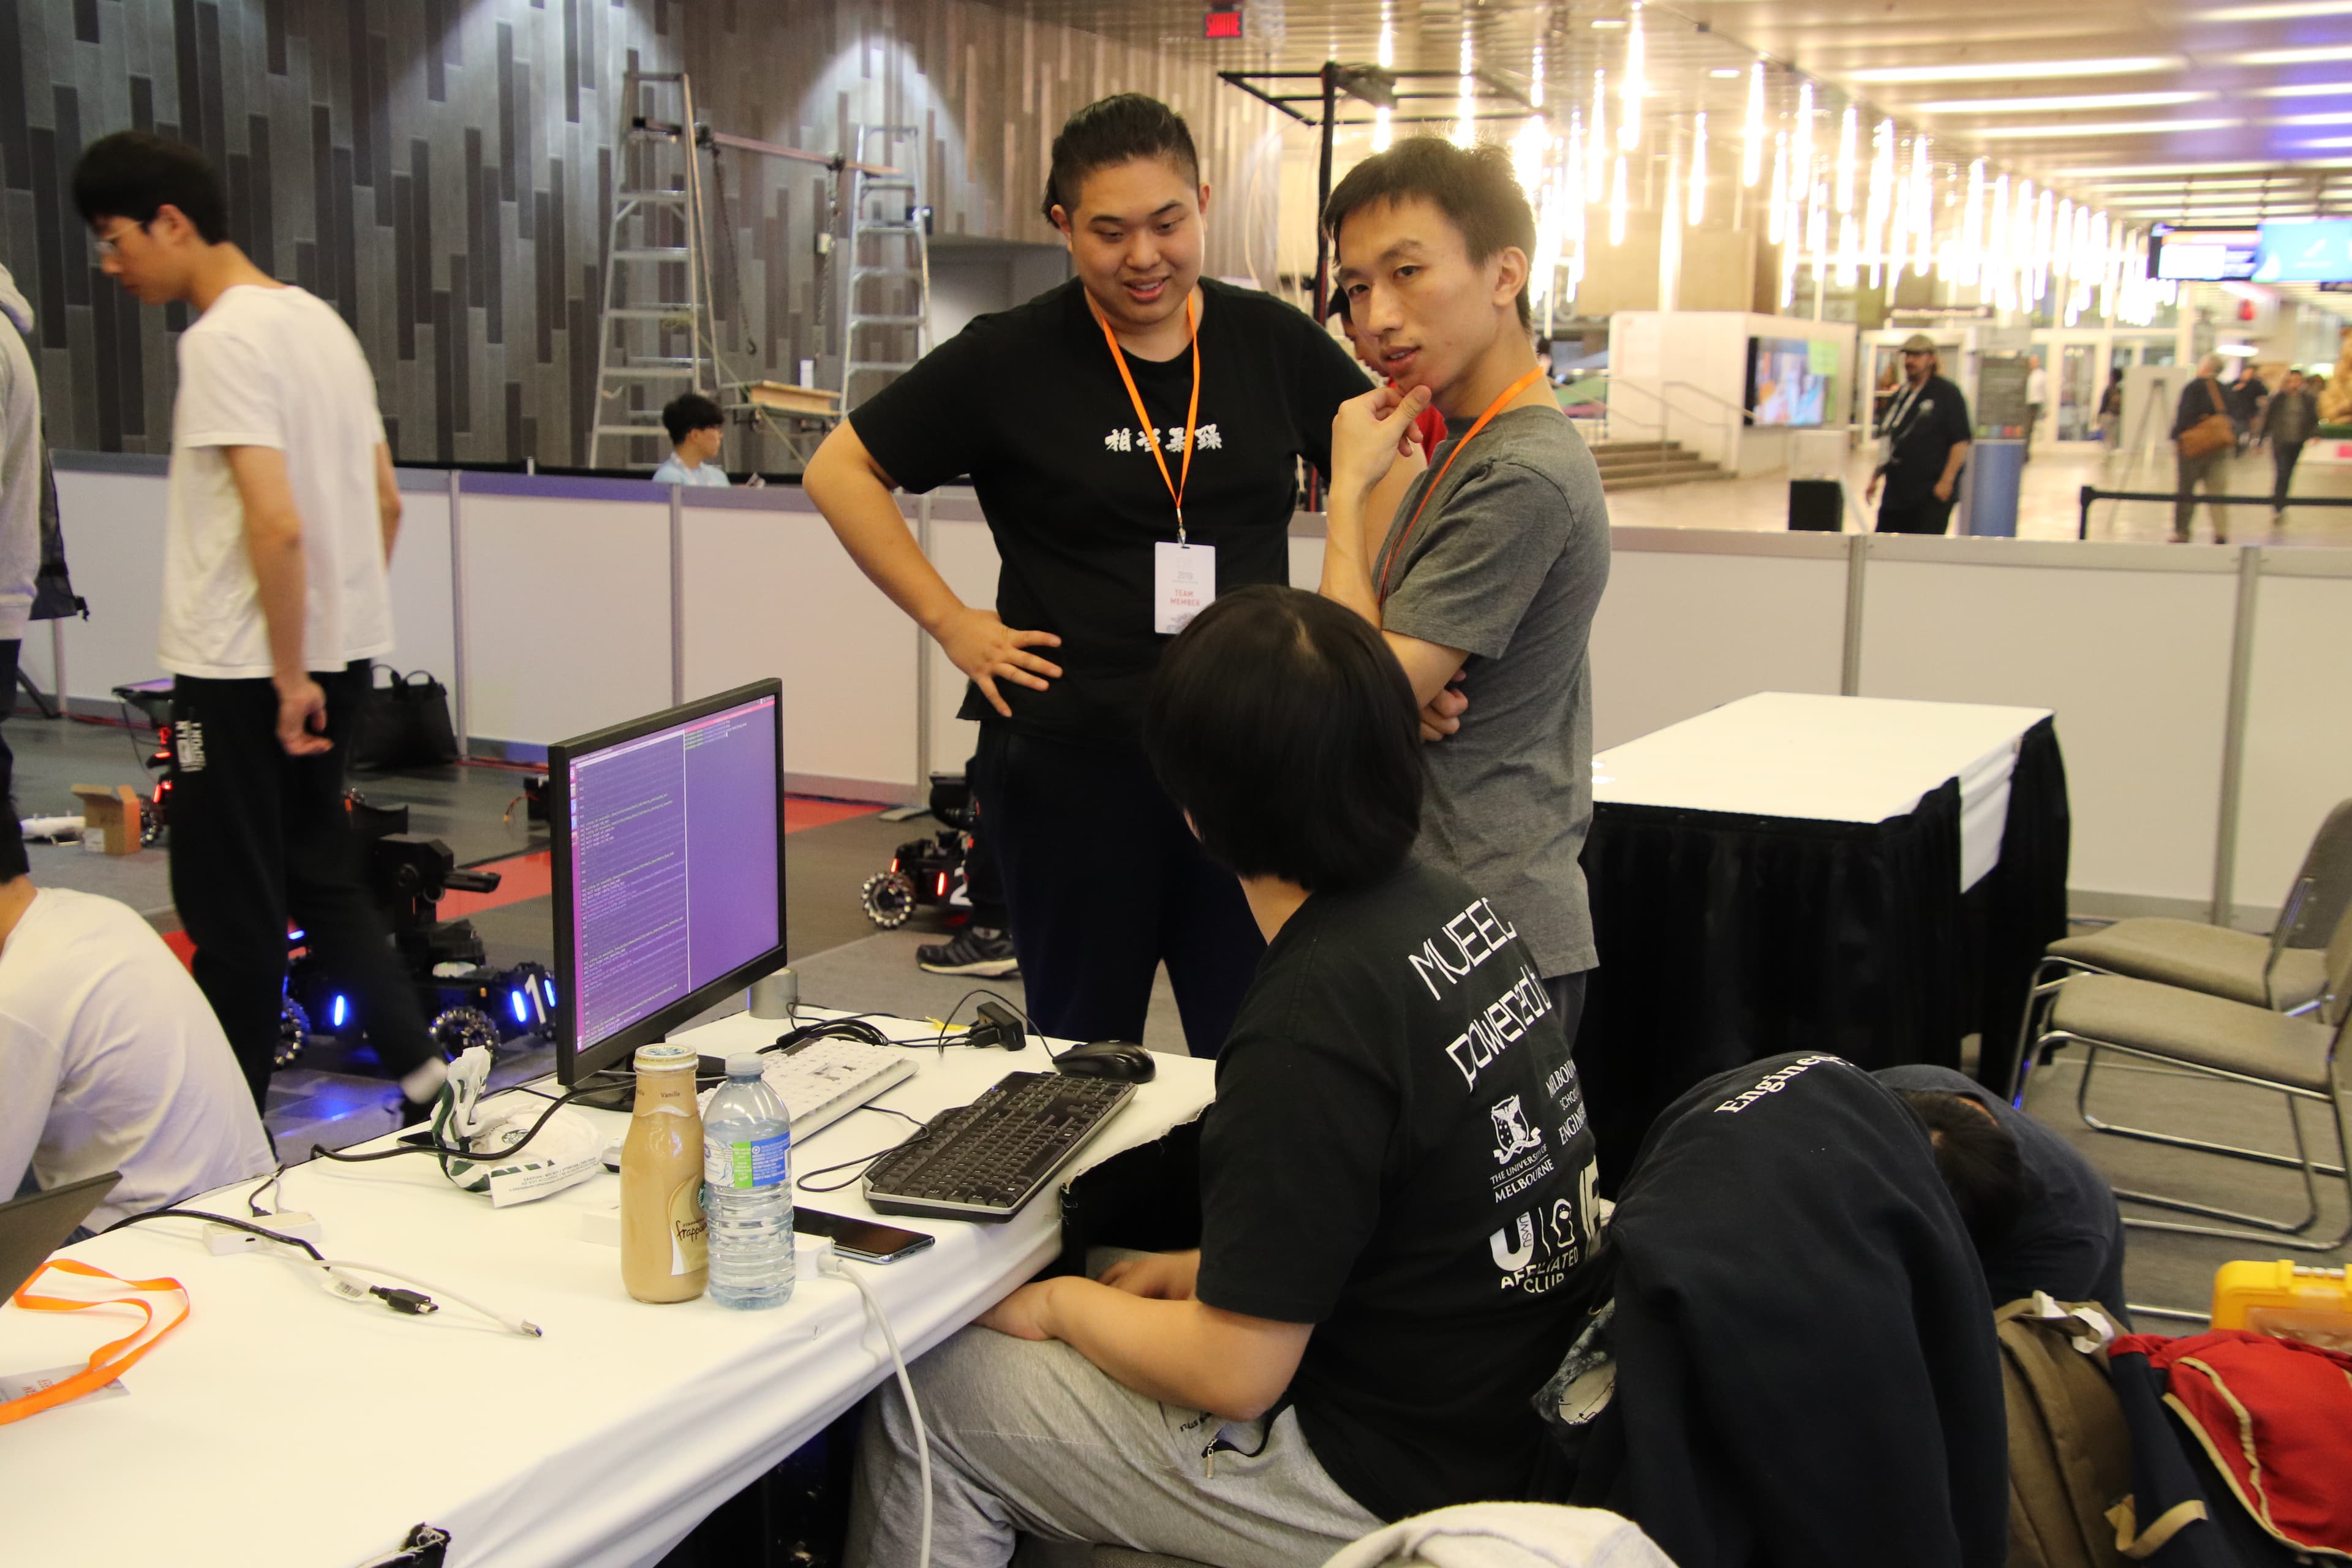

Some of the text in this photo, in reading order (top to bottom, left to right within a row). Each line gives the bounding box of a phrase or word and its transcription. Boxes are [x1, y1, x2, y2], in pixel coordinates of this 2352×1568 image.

[1170, 598, 1200, 606] MEMBER
[524, 973, 546, 1024] 1
[1490, 1170, 1506, 1185] THE
[1506, 1150, 1542, 1177] UNIVERSITY
[1540, 1143, 1547, 1154] OF
[1494, 1158, 1555, 1204] MELBOURNE
